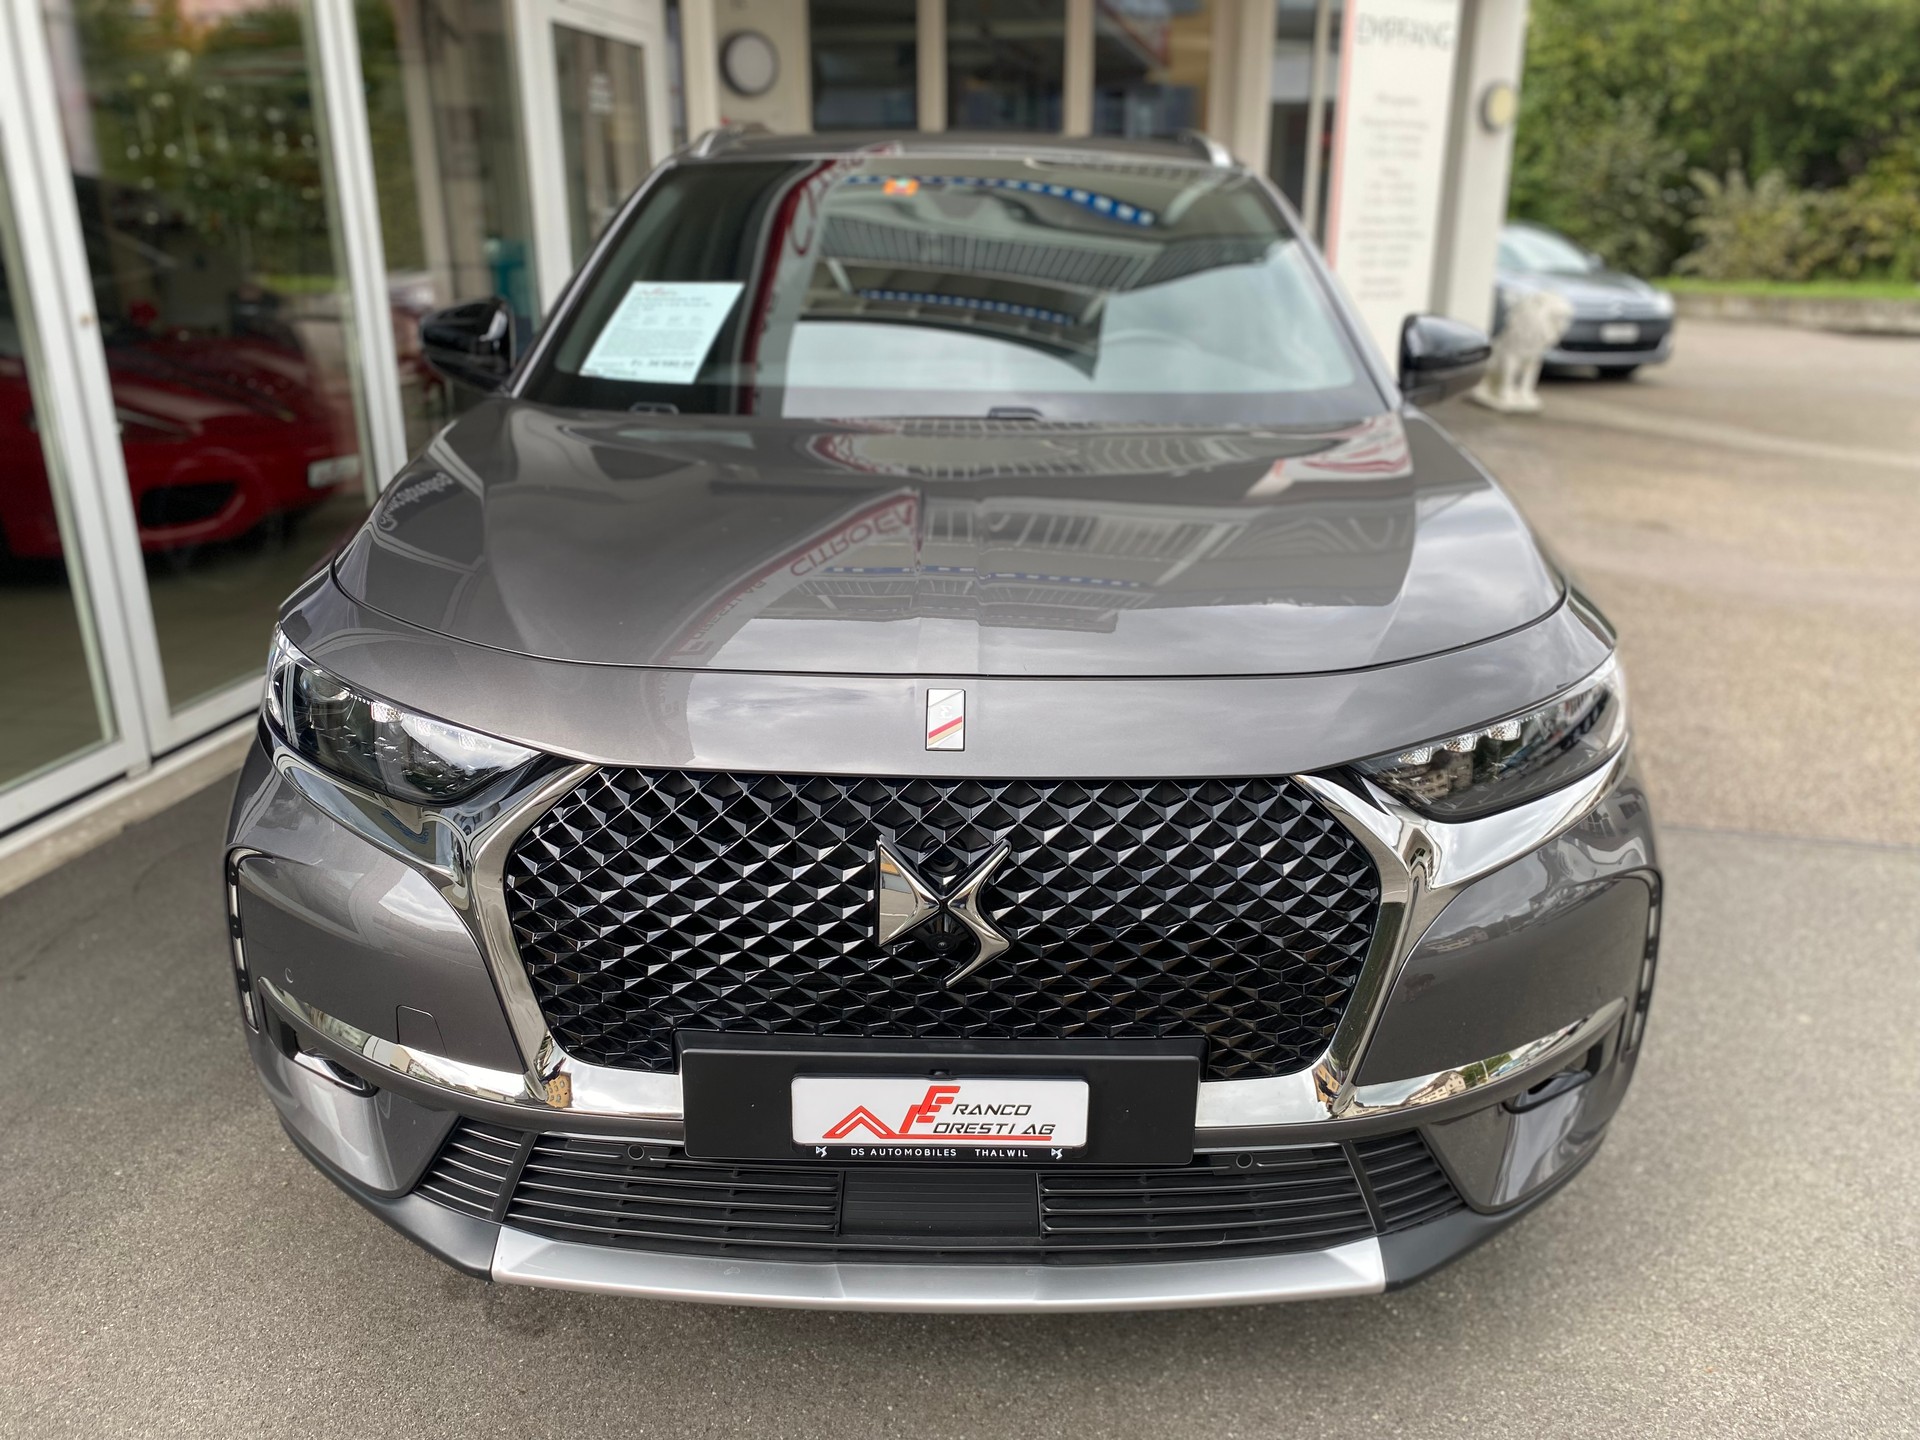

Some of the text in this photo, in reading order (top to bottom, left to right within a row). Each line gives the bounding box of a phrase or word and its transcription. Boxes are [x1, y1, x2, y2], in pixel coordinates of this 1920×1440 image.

[1021, 1123, 1056, 1135] AG
[850, 1148, 1029, 1157] DS AUTOMOBILES THALWIL
